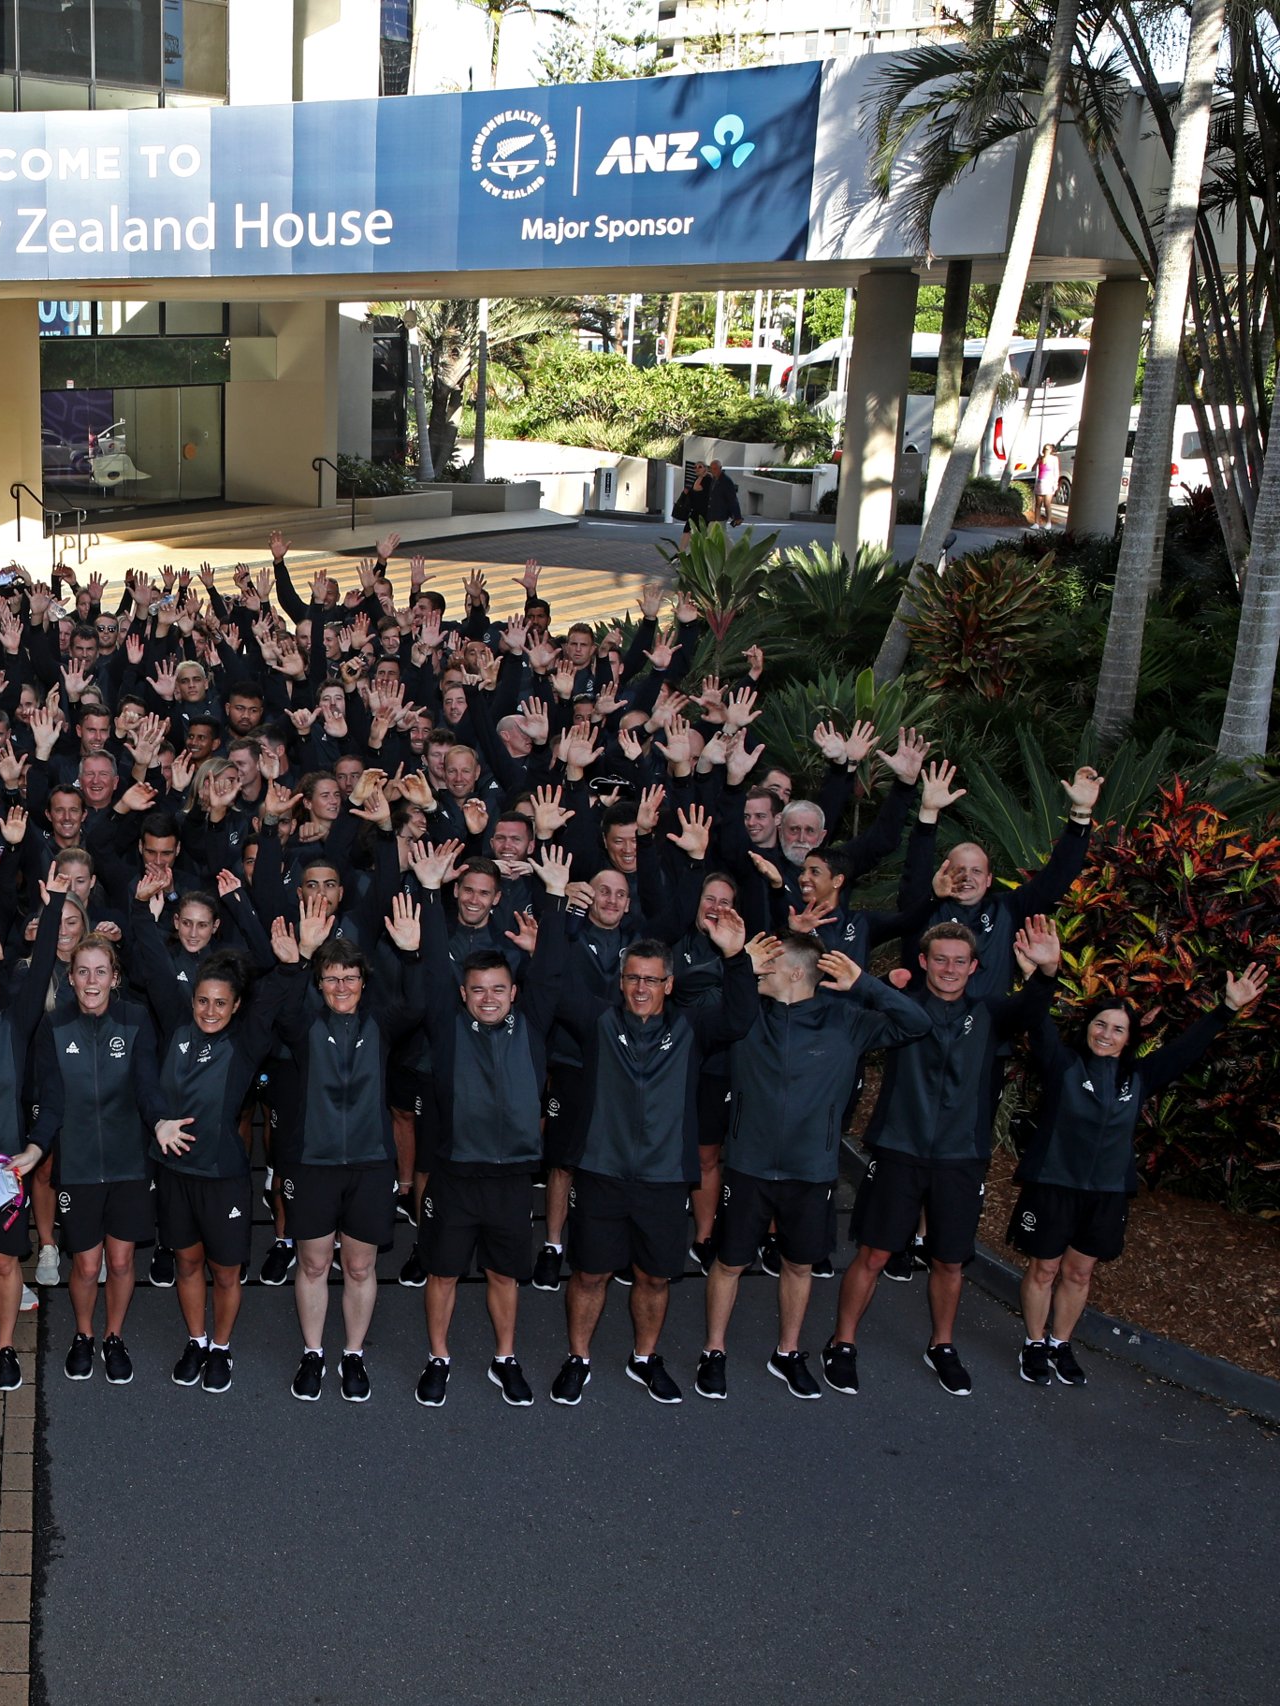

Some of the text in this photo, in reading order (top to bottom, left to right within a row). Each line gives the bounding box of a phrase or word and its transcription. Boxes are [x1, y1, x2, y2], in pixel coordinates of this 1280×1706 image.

[471, 110, 556, 171] COMMONWEALTH GAMES
[596, 131, 700, 176] ANZ
[139, 144, 201, 178] TO
[480, 176, 545, 199] NEW ZEALAND
[16, 202, 215, 253] Zealand
[235, 202, 394, 249] House
[521, 214, 694, 245] Major Sponsor
